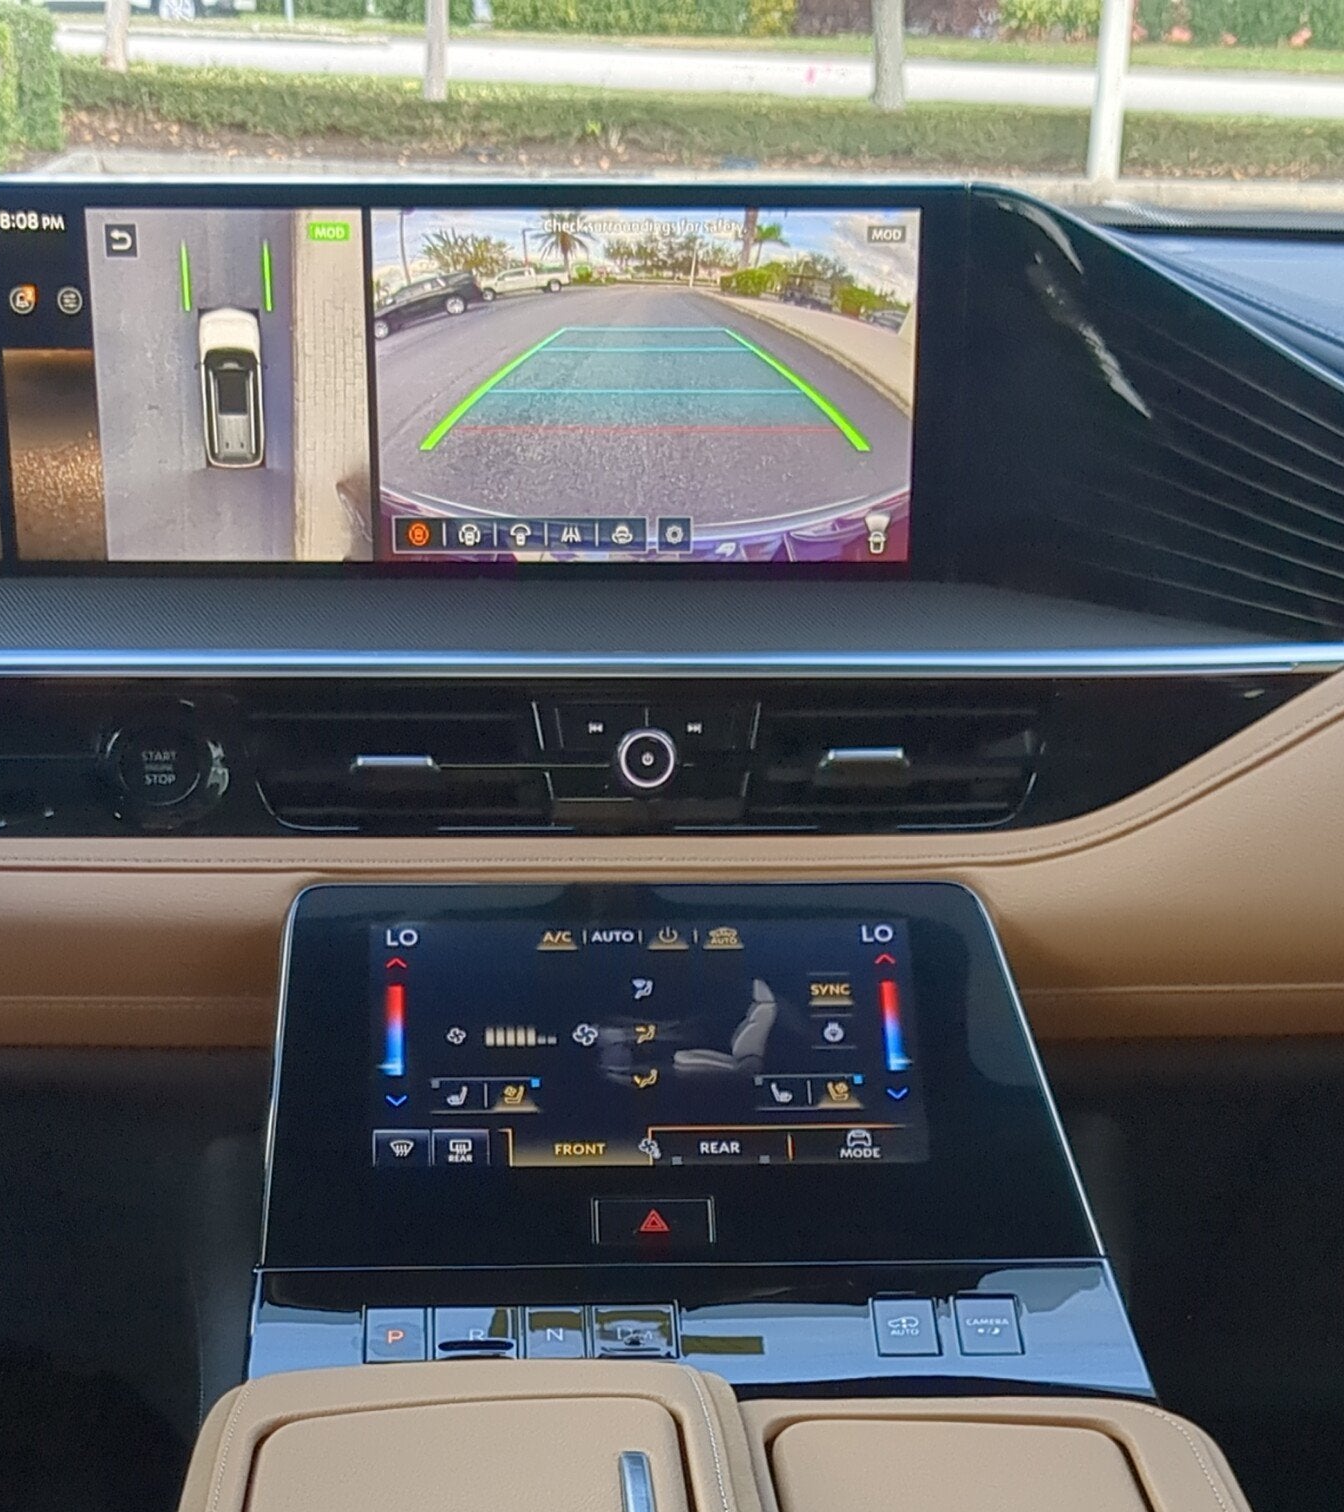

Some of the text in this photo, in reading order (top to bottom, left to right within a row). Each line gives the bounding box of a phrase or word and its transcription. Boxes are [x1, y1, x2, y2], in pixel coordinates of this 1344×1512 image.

[0, 211, 65, 230] 8:08 PM
[544, 219, 584, 233] Check
[314, 225, 346, 239] MOD
[871, 228, 902, 241] MOD
[141, 750, 177, 761] START
[145, 773, 177, 786] STOP
[386, 929, 419, 947] LO
[543, 931, 572, 943] A/C
[591, 930, 635, 943] AUTO
[861, 925, 894, 943] LO
[810, 984, 851, 996] SYNC
[554, 1143, 606, 1156] FRONT
[700, 1141, 740, 1154] REAR
[840, 1148, 881, 1159] MODE
[448, 1154, 473, 1163] REAR
[965, 1318, 1009, 1326] CAMERA
[387, 1330, 405, 1344] P
[469, 1329, 485, 1341] R
[546, 1328, 564, 1342] N
